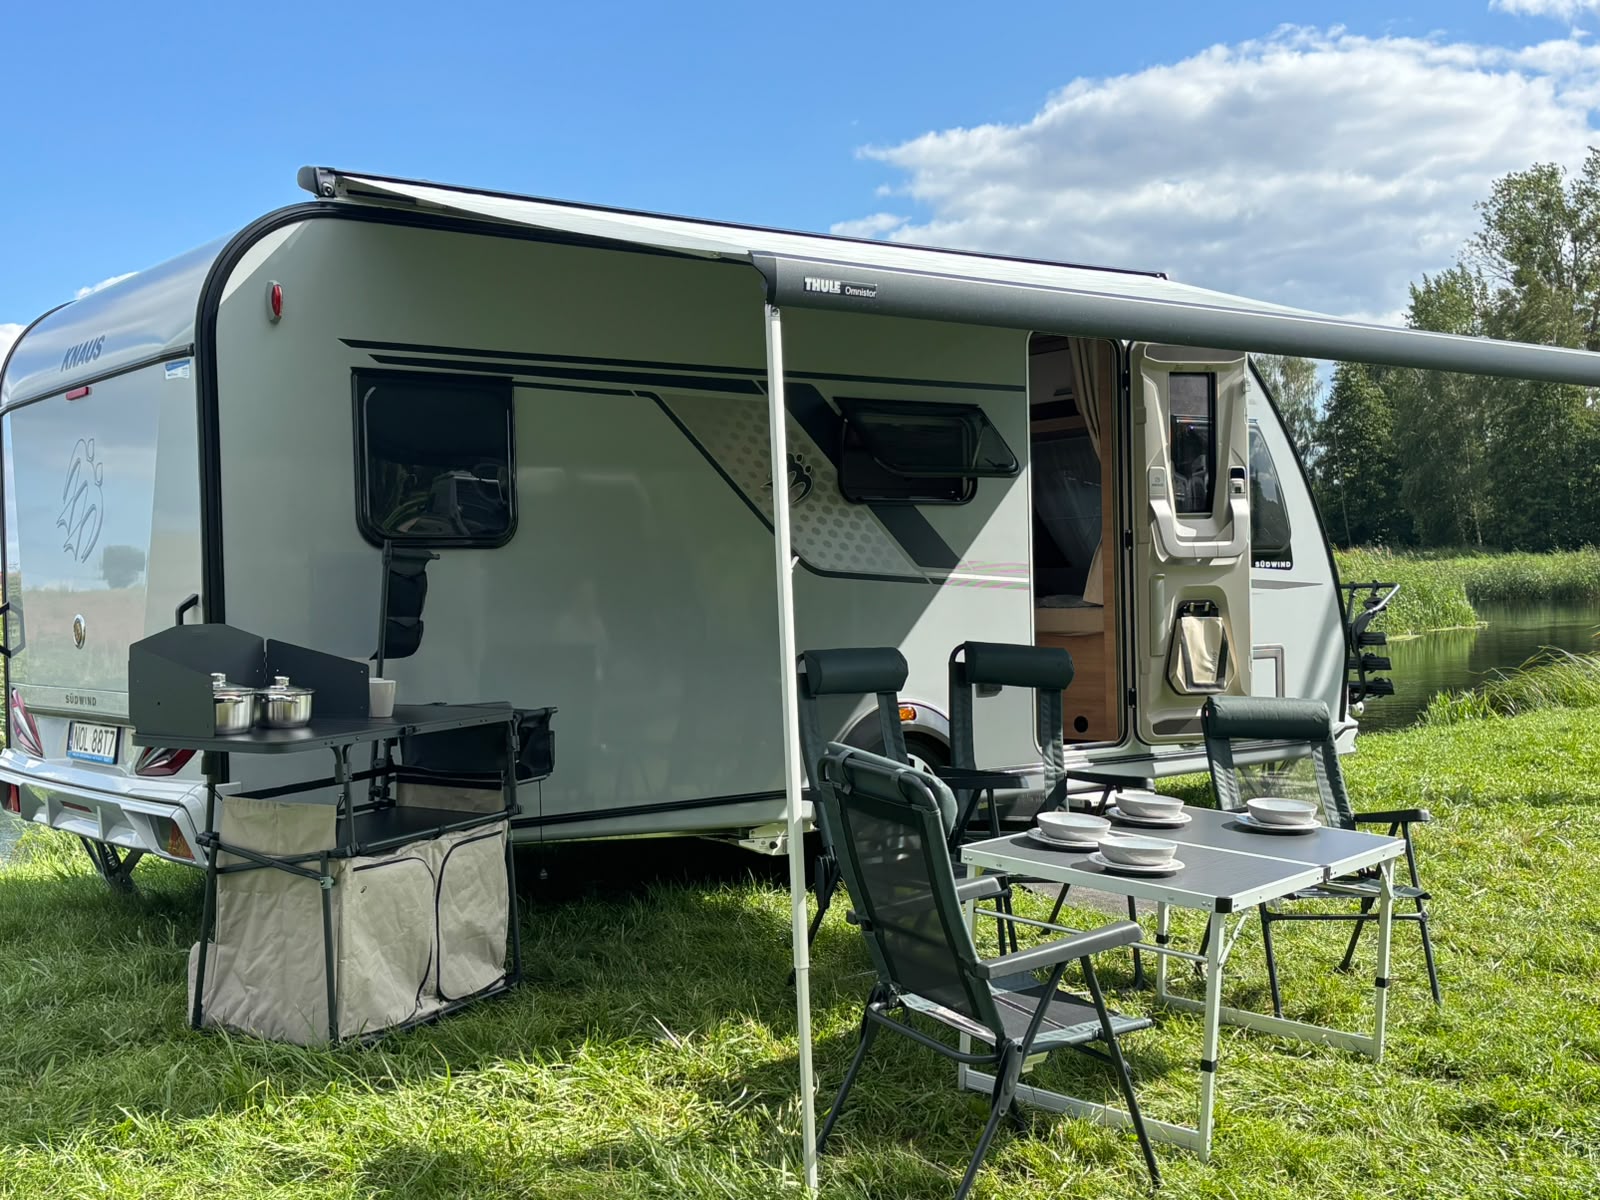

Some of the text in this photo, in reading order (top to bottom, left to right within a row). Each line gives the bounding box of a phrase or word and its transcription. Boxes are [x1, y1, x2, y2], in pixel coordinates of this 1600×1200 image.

[804, 278, 876, 297] THULE Omnistor
[61, 336, 105, 371] KNAUS
[1255, 560, 1291, 568] SÜDWIND
[65, 693, 96, 705] SÜDWIND
[73, 725, 88, 751] NOL
